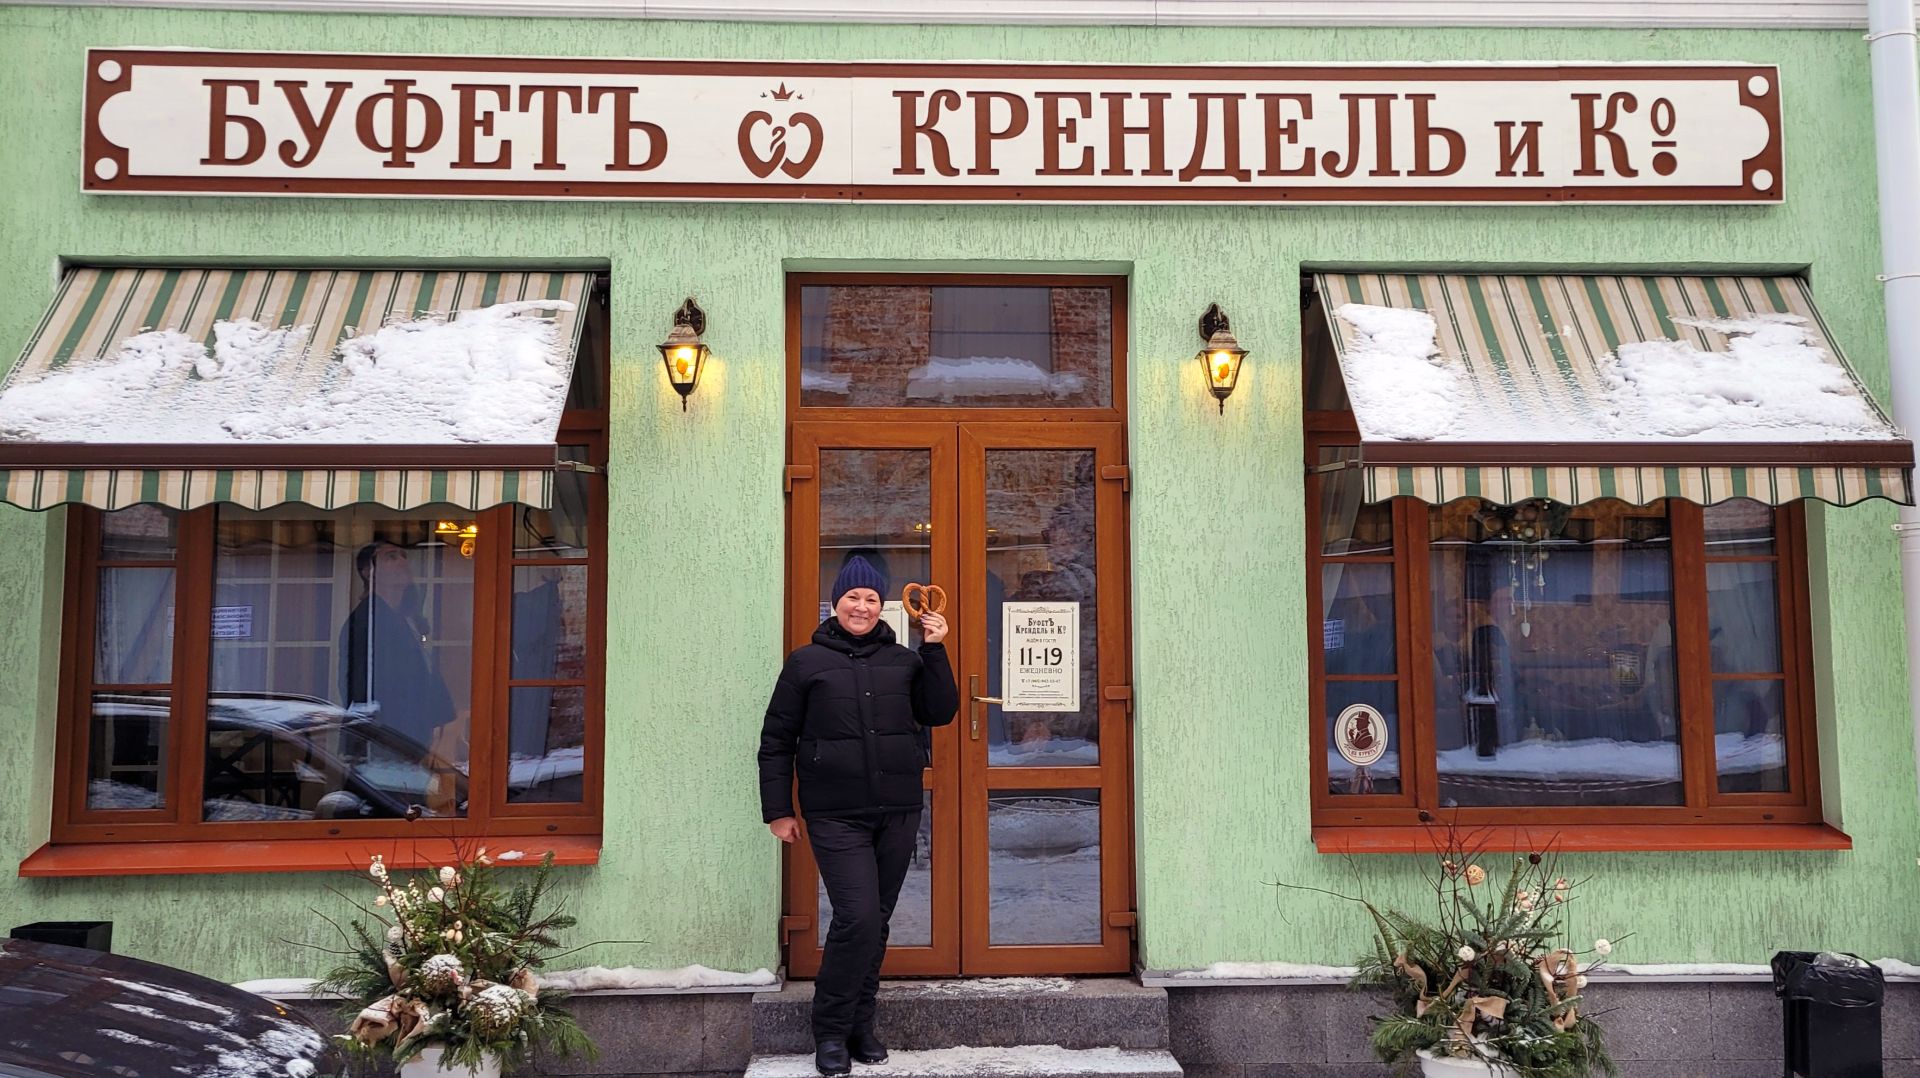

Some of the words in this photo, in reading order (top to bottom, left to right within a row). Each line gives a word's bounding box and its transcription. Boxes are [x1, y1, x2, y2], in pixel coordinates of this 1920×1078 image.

[202, 79, 669, 172] БУФЕТЪ
[892, 88, 1467, 182] КРЕНДЕЛЬ
[1020, 647, 1062, 665] 11-19
